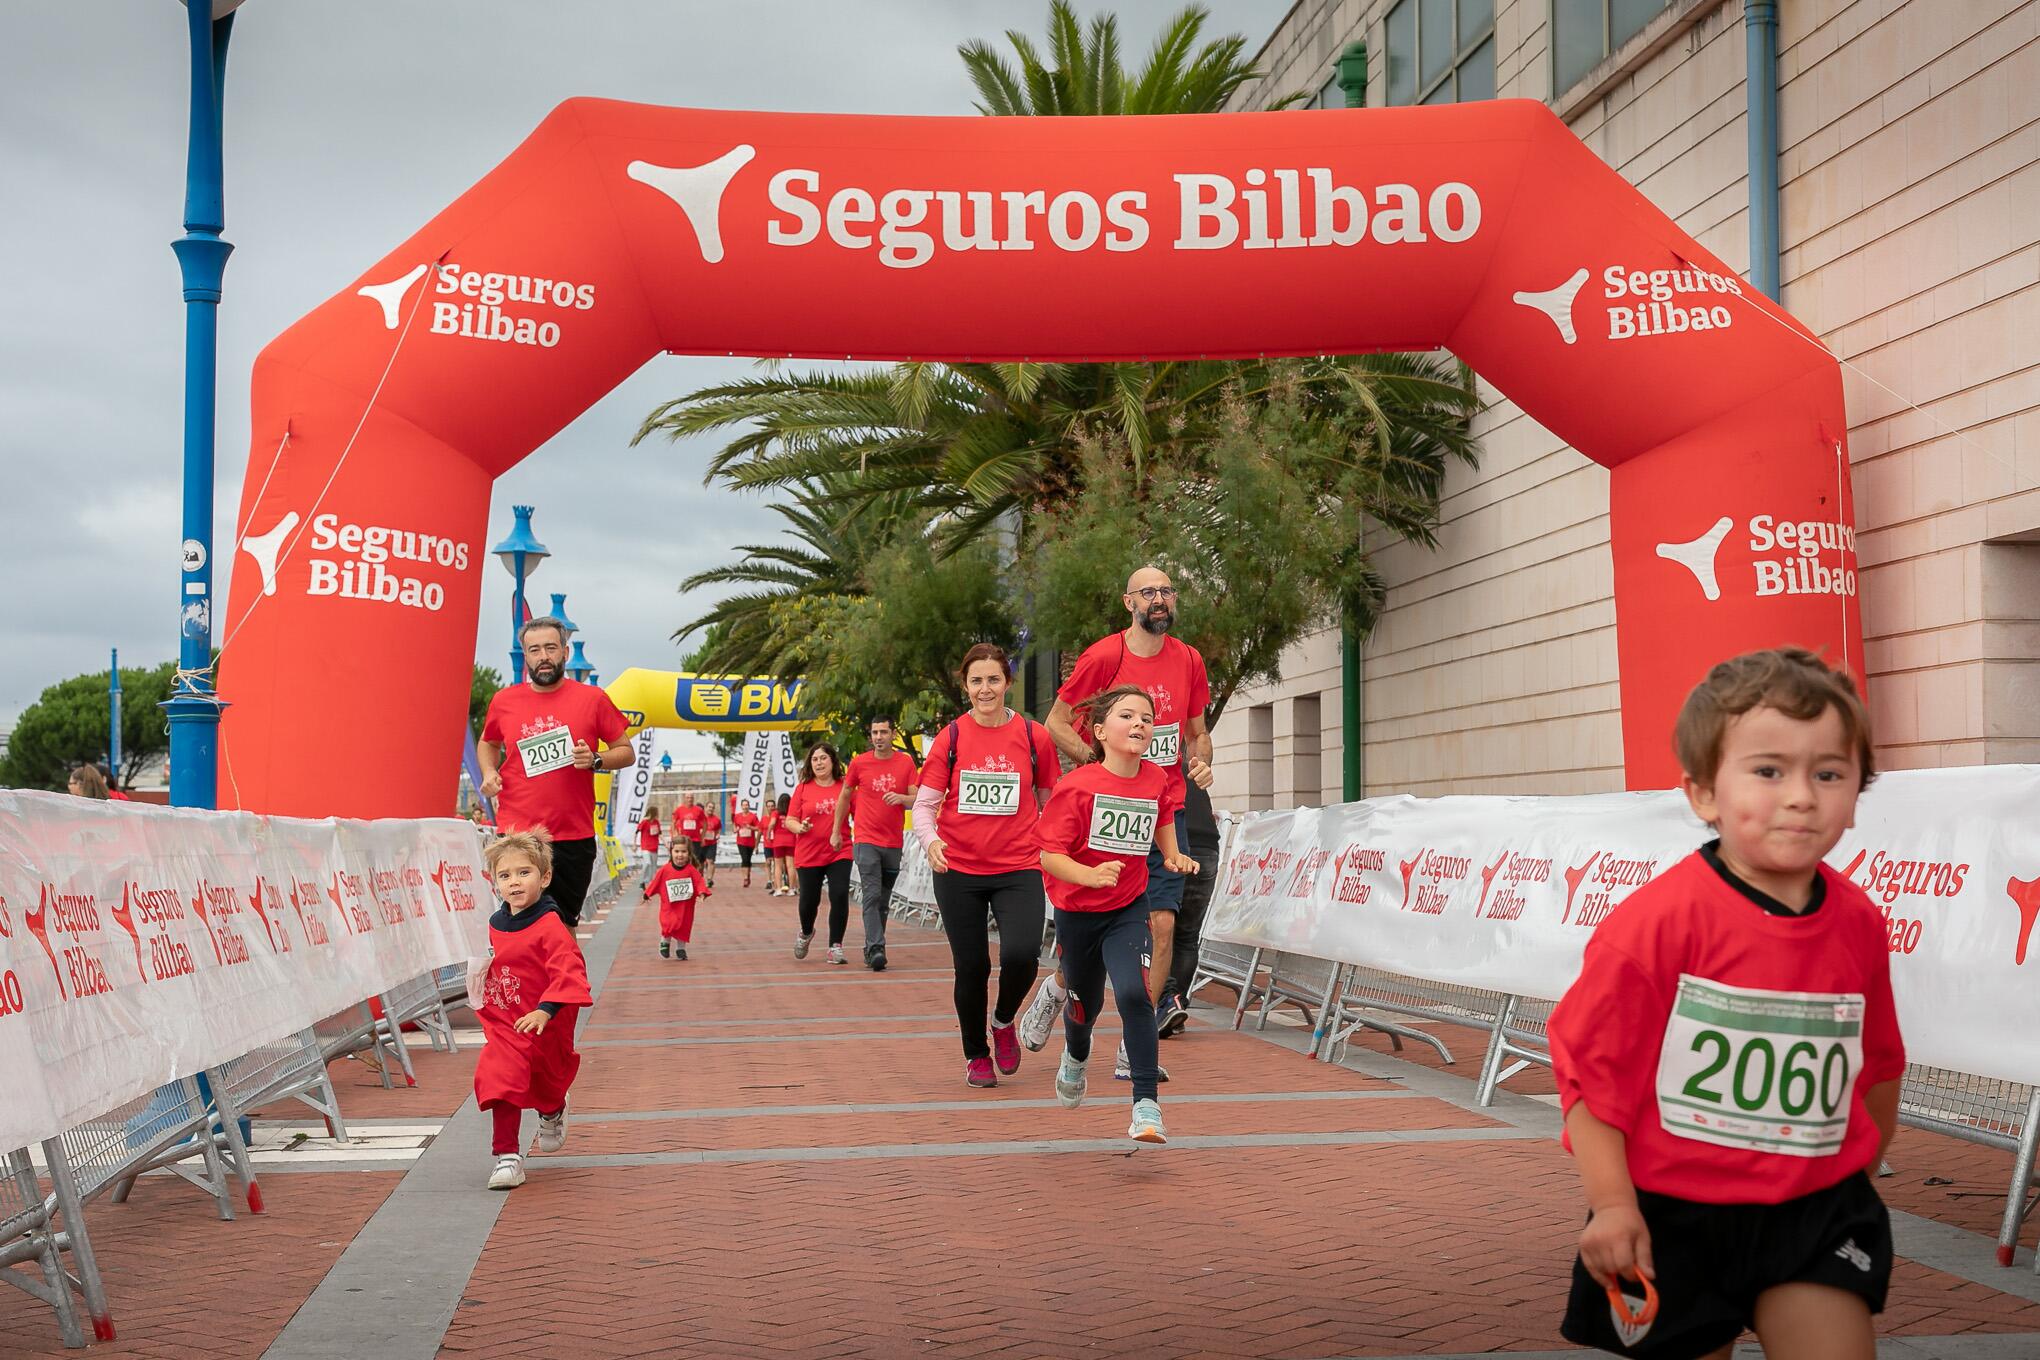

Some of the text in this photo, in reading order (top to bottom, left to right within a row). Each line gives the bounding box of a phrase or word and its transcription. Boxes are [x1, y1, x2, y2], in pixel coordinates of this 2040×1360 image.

[768, 168, 1482, 268] Seguros Bilbao
[435, 263, 595, 310] Seguros
[1603, 265, 1743, 302] Seguros
[429, 302, 561, 348] Bilbao
[1607, 302, 1732, 340] Bilbao
[310, 514, 469, 571] Seguros
[1749, 514, 1856, 557] Seguro
[306, 559, 444, 611] Bilbao
[1753, 557, 1856, 597] Bilbao
[527, 738, 568, 766] 2037
[1141, 736, 1177, 757] 043
[966, 784, 1014, 805] 2037
[1099, 810, 1153, 842] 2043
[1349, 844, 1386, 875] Seguros
[1420, 848, 1472, 884] Seguros
[1503, 851, 1554, 887] Seguros
[1592, 852, 1658, 892] Seguros
[1861, 850, 1970, 903] Seguros
[1338, 876, 1371, 904] Bilbao
[1412, 885, 1450, 915] Bilbao
[1487, 889, 1526, 921] Bilbao
[1682, 1030, 1849, 1118] 2060
